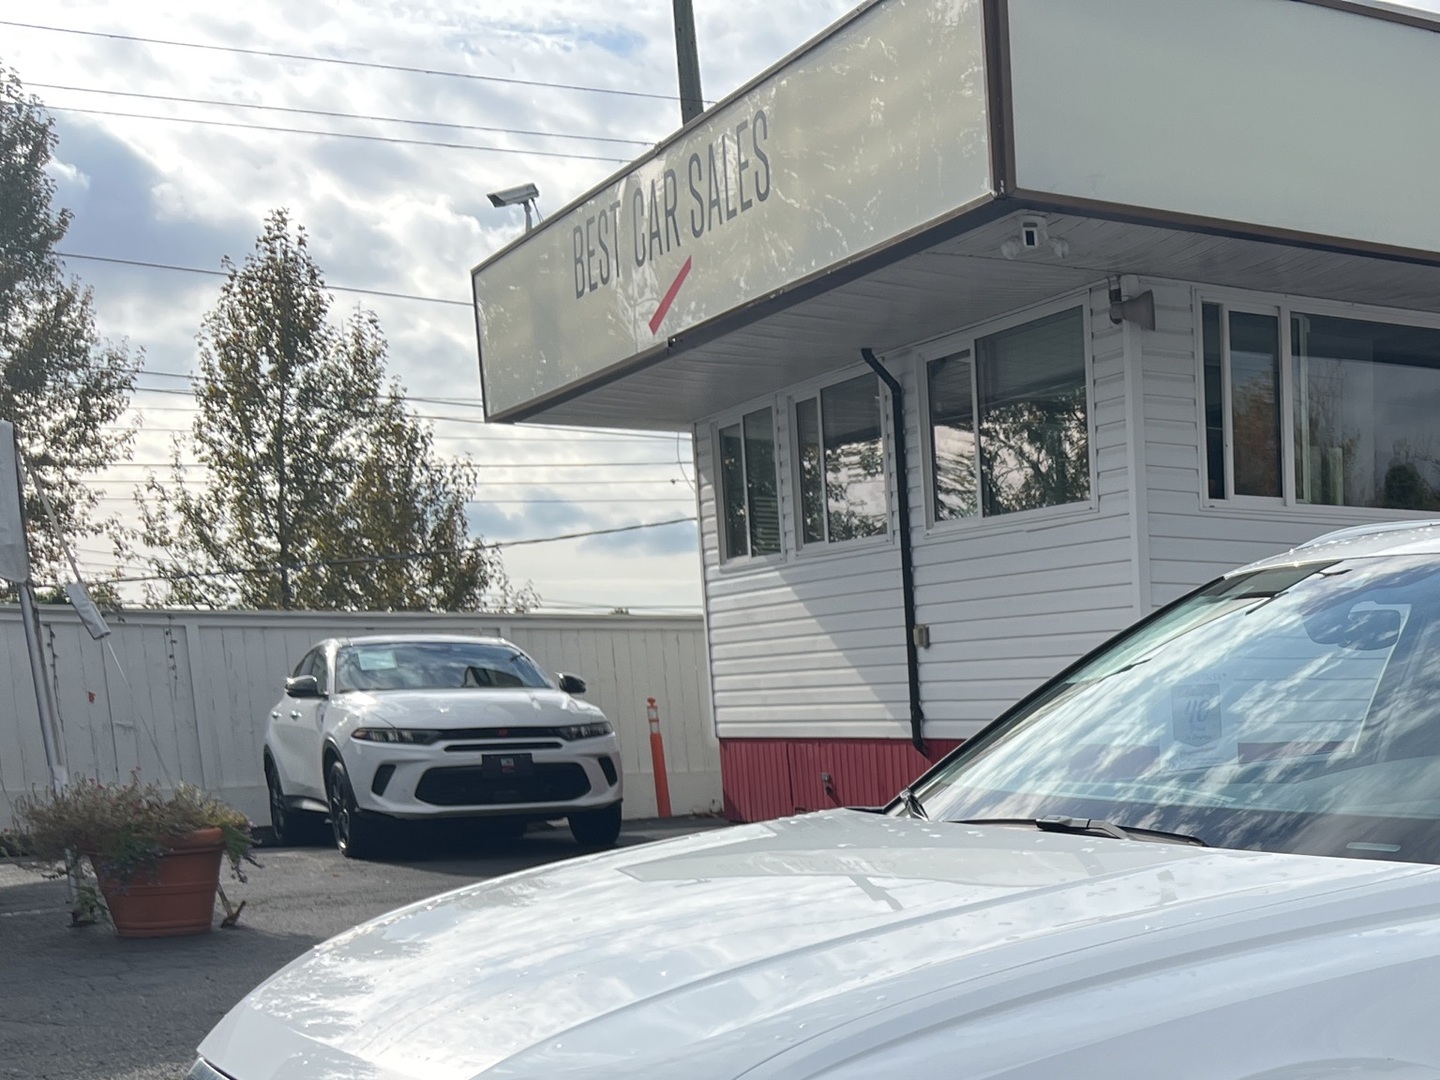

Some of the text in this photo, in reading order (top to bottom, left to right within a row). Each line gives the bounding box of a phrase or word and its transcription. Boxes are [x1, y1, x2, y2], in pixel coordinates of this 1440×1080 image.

[573, 109, 771, 300] BEST CAR SALES
